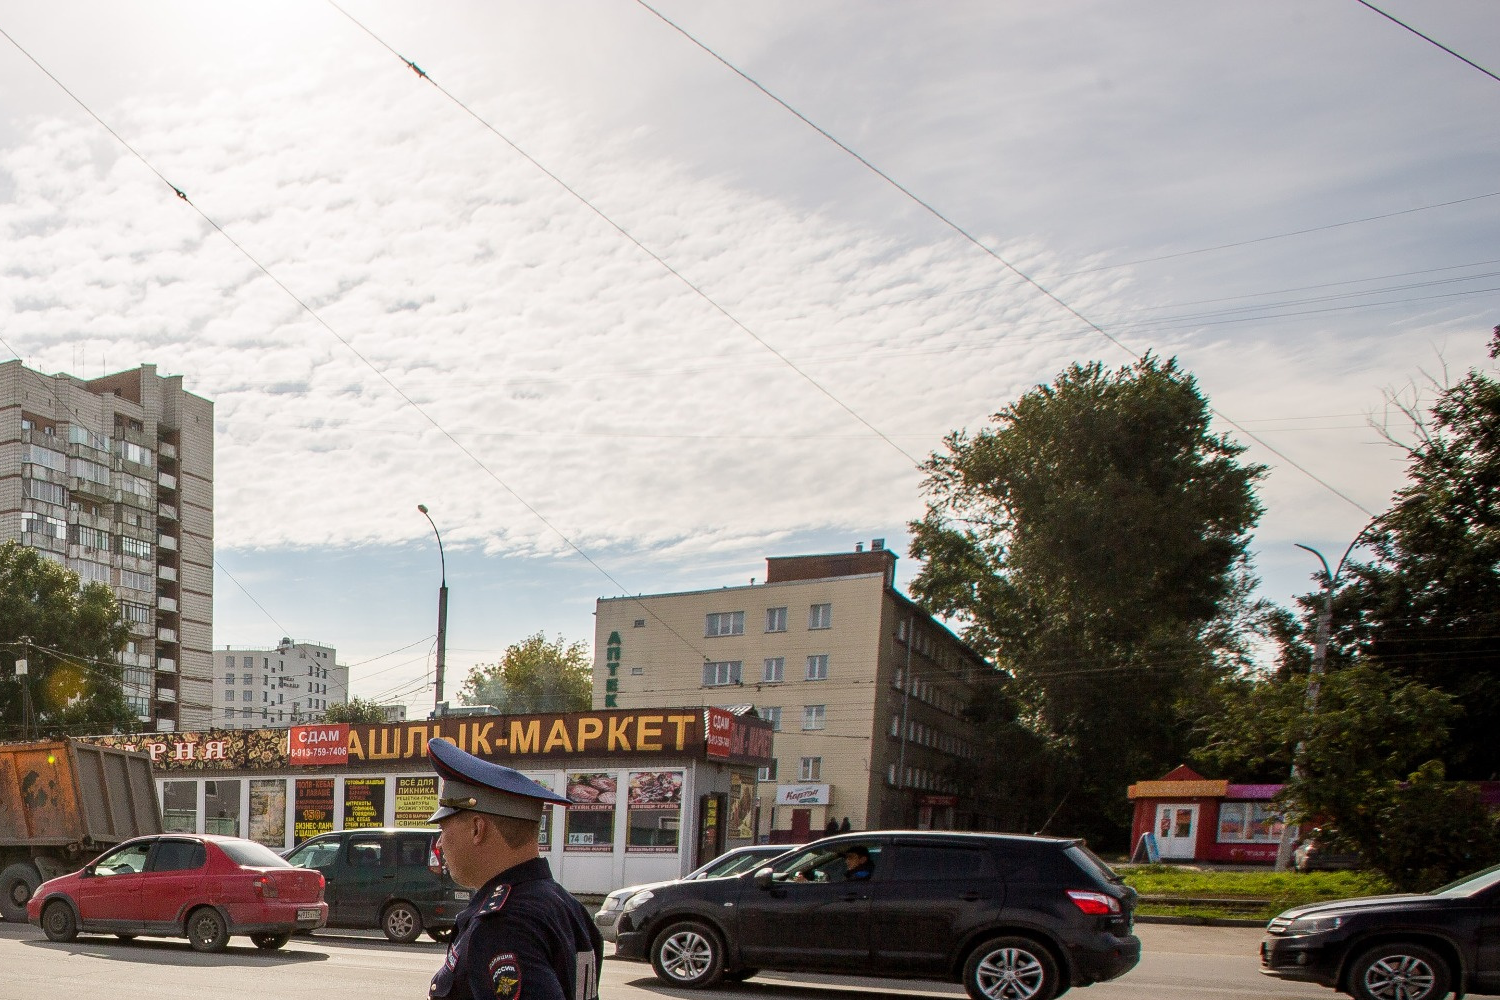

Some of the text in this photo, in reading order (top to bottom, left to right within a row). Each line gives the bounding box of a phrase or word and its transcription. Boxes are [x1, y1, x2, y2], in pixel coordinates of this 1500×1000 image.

[713, 714, 730, 731] СДАМ
[298, 730, 340, 744] СДАМ
[347, 714, 696, 761] АШЛЫК-МАРКЕТ
[291, 747, 347, 757] 8-913-759-7406
[417, 779, 434, 787] ДЛЯ
[398, 787, 435, 795] ПИКНИКА
[570, 834, 593, 843] 74 06
[492, 965, 516, 983] РОССИЯ
